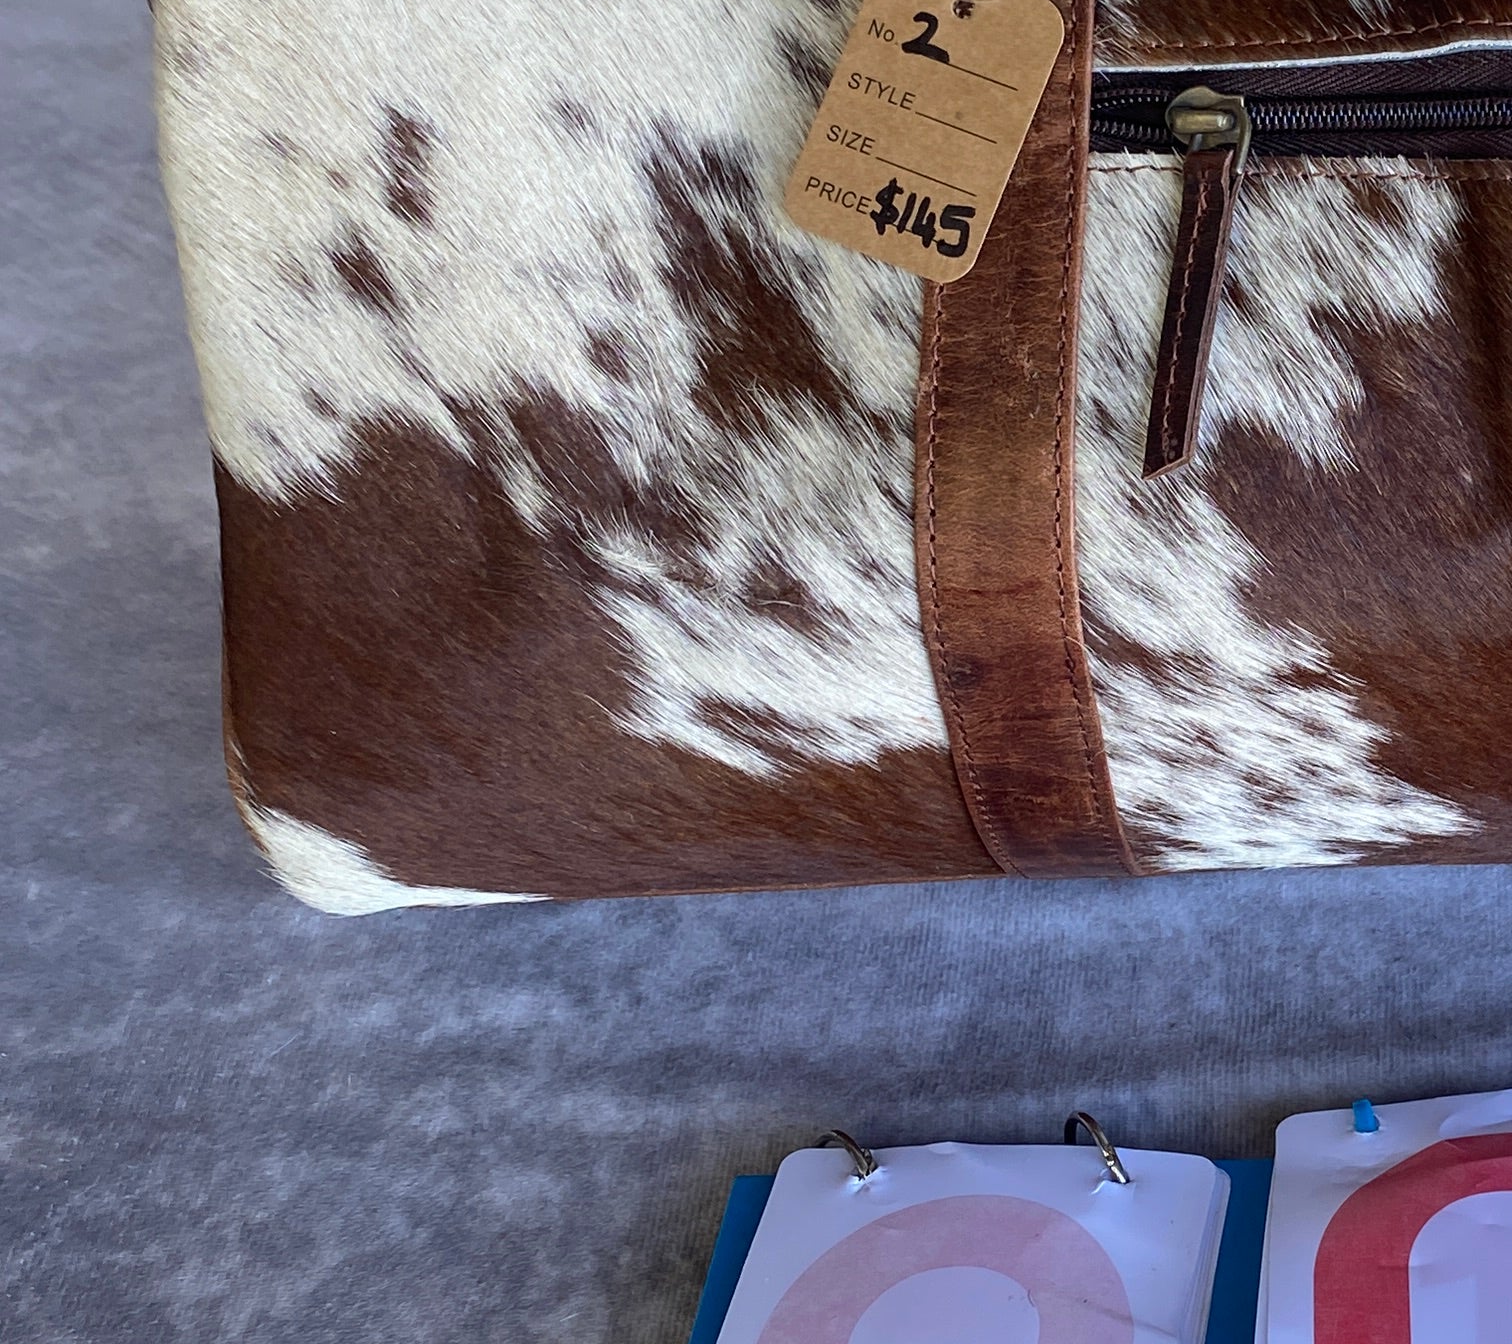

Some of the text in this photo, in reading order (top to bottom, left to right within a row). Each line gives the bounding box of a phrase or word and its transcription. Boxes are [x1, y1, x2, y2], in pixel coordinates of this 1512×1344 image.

[902, 12, 950, 64] 2
[848, 73, 916, 110] STYLE
[827, 125, 876, 155] SIZE
[805, 176, 975, 257] PRICE $145
